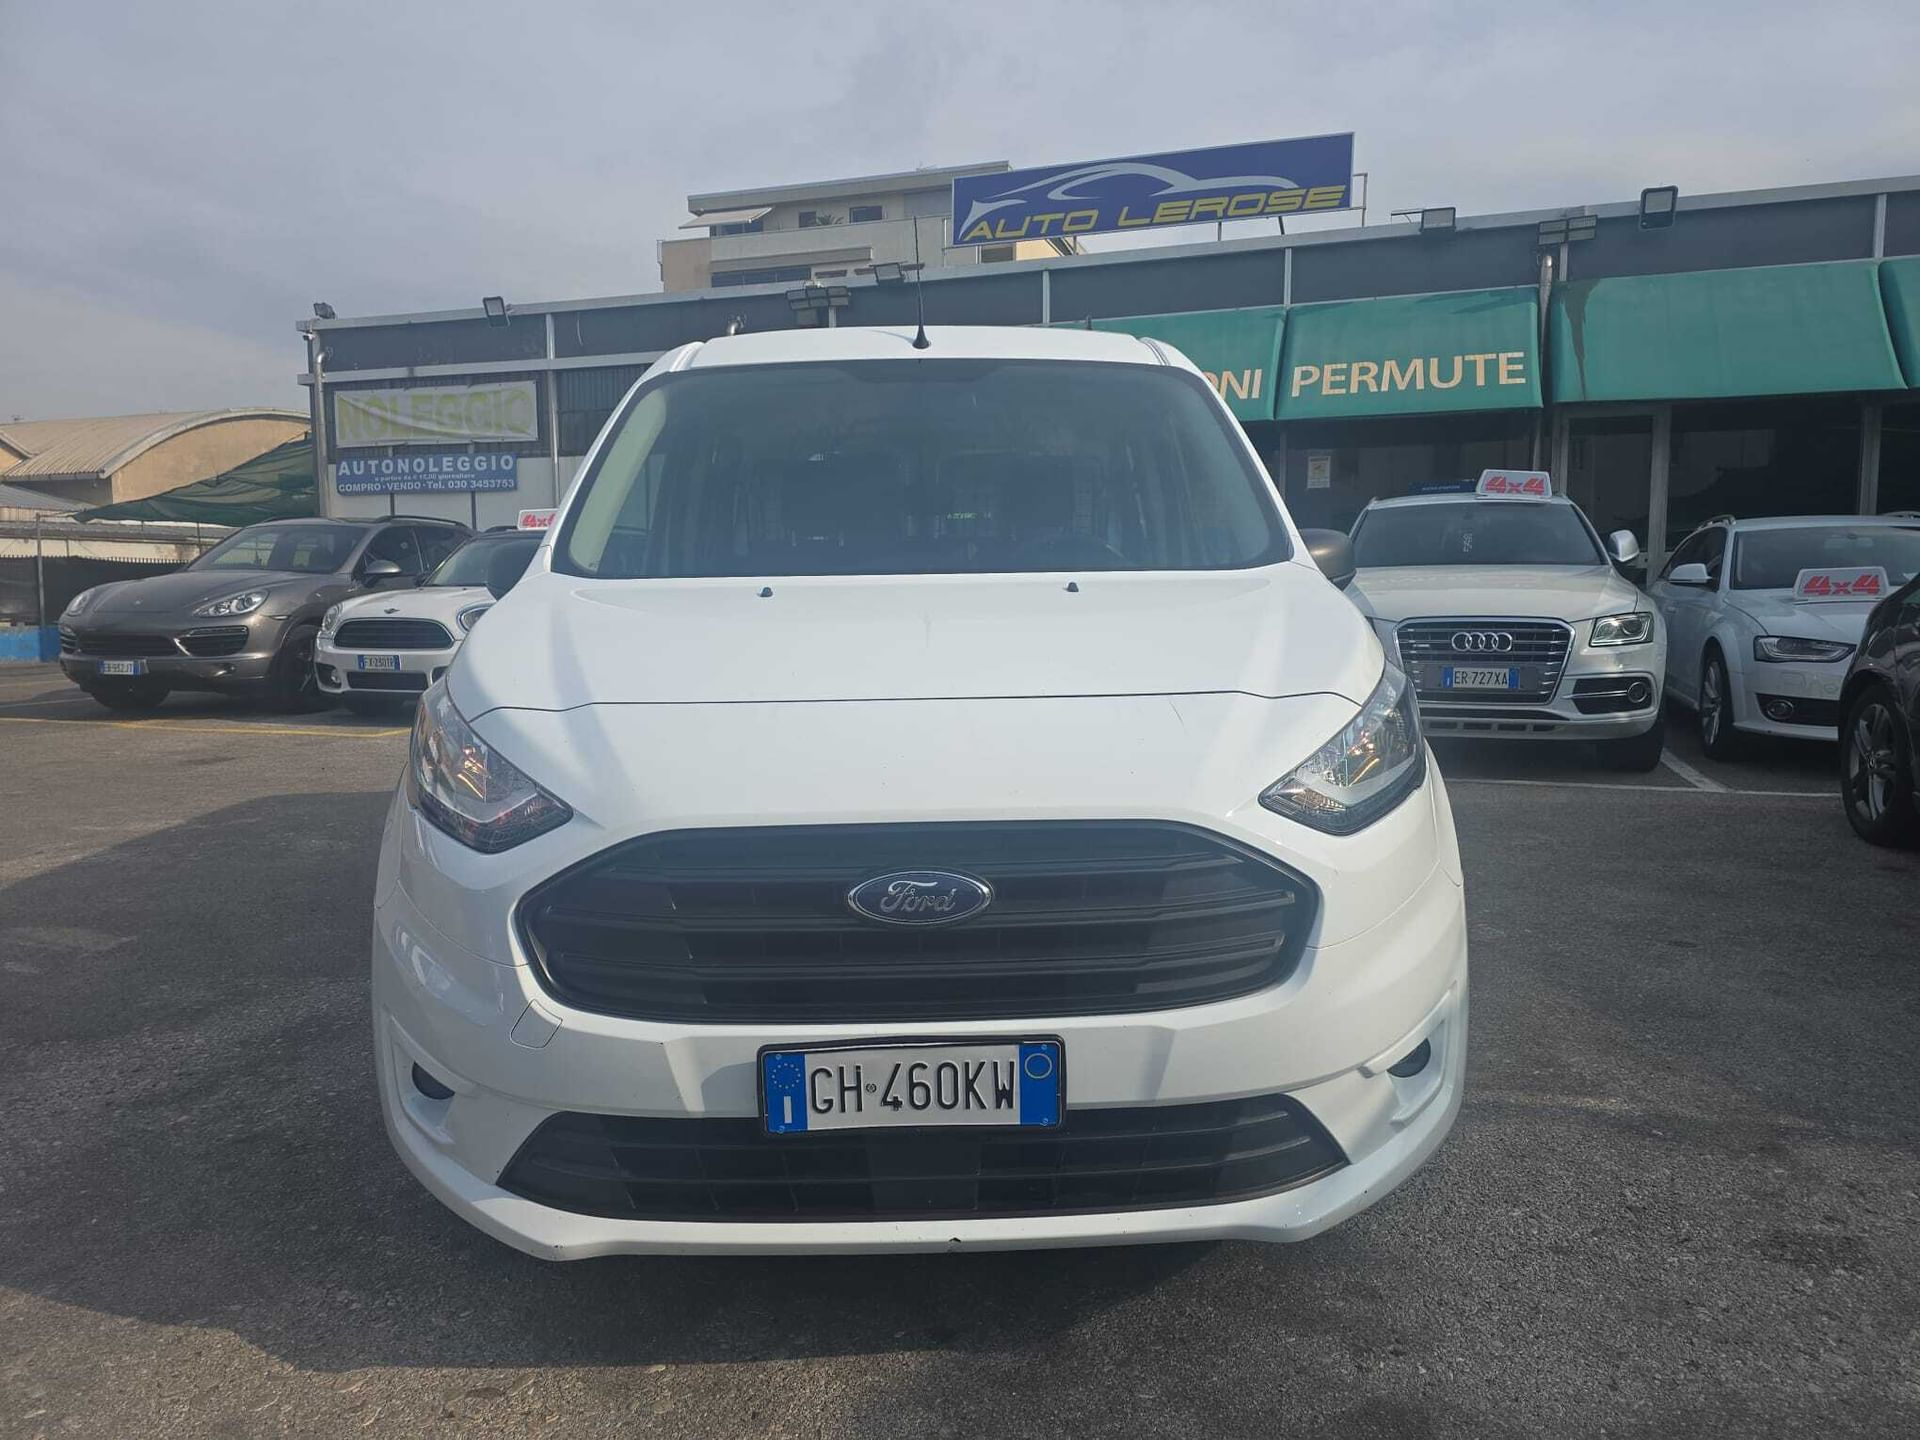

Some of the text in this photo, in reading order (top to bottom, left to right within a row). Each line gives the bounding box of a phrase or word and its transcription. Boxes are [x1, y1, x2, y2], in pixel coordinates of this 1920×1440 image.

[963, 184, 1347, 241] AUTO LEROSE
[1290, 351, 1527, 398] PERMUTE
[336, 389, 534, 441] NOLEGGIO
[338, 455, 514, 476] AUTONOLEGGIO
[448, 479, 467, 489] 030
[879, 880, 958, 912] Ford
[810, 1064, 864, 1115] GH
[880, 1060, 1016, 1112] 460KW
